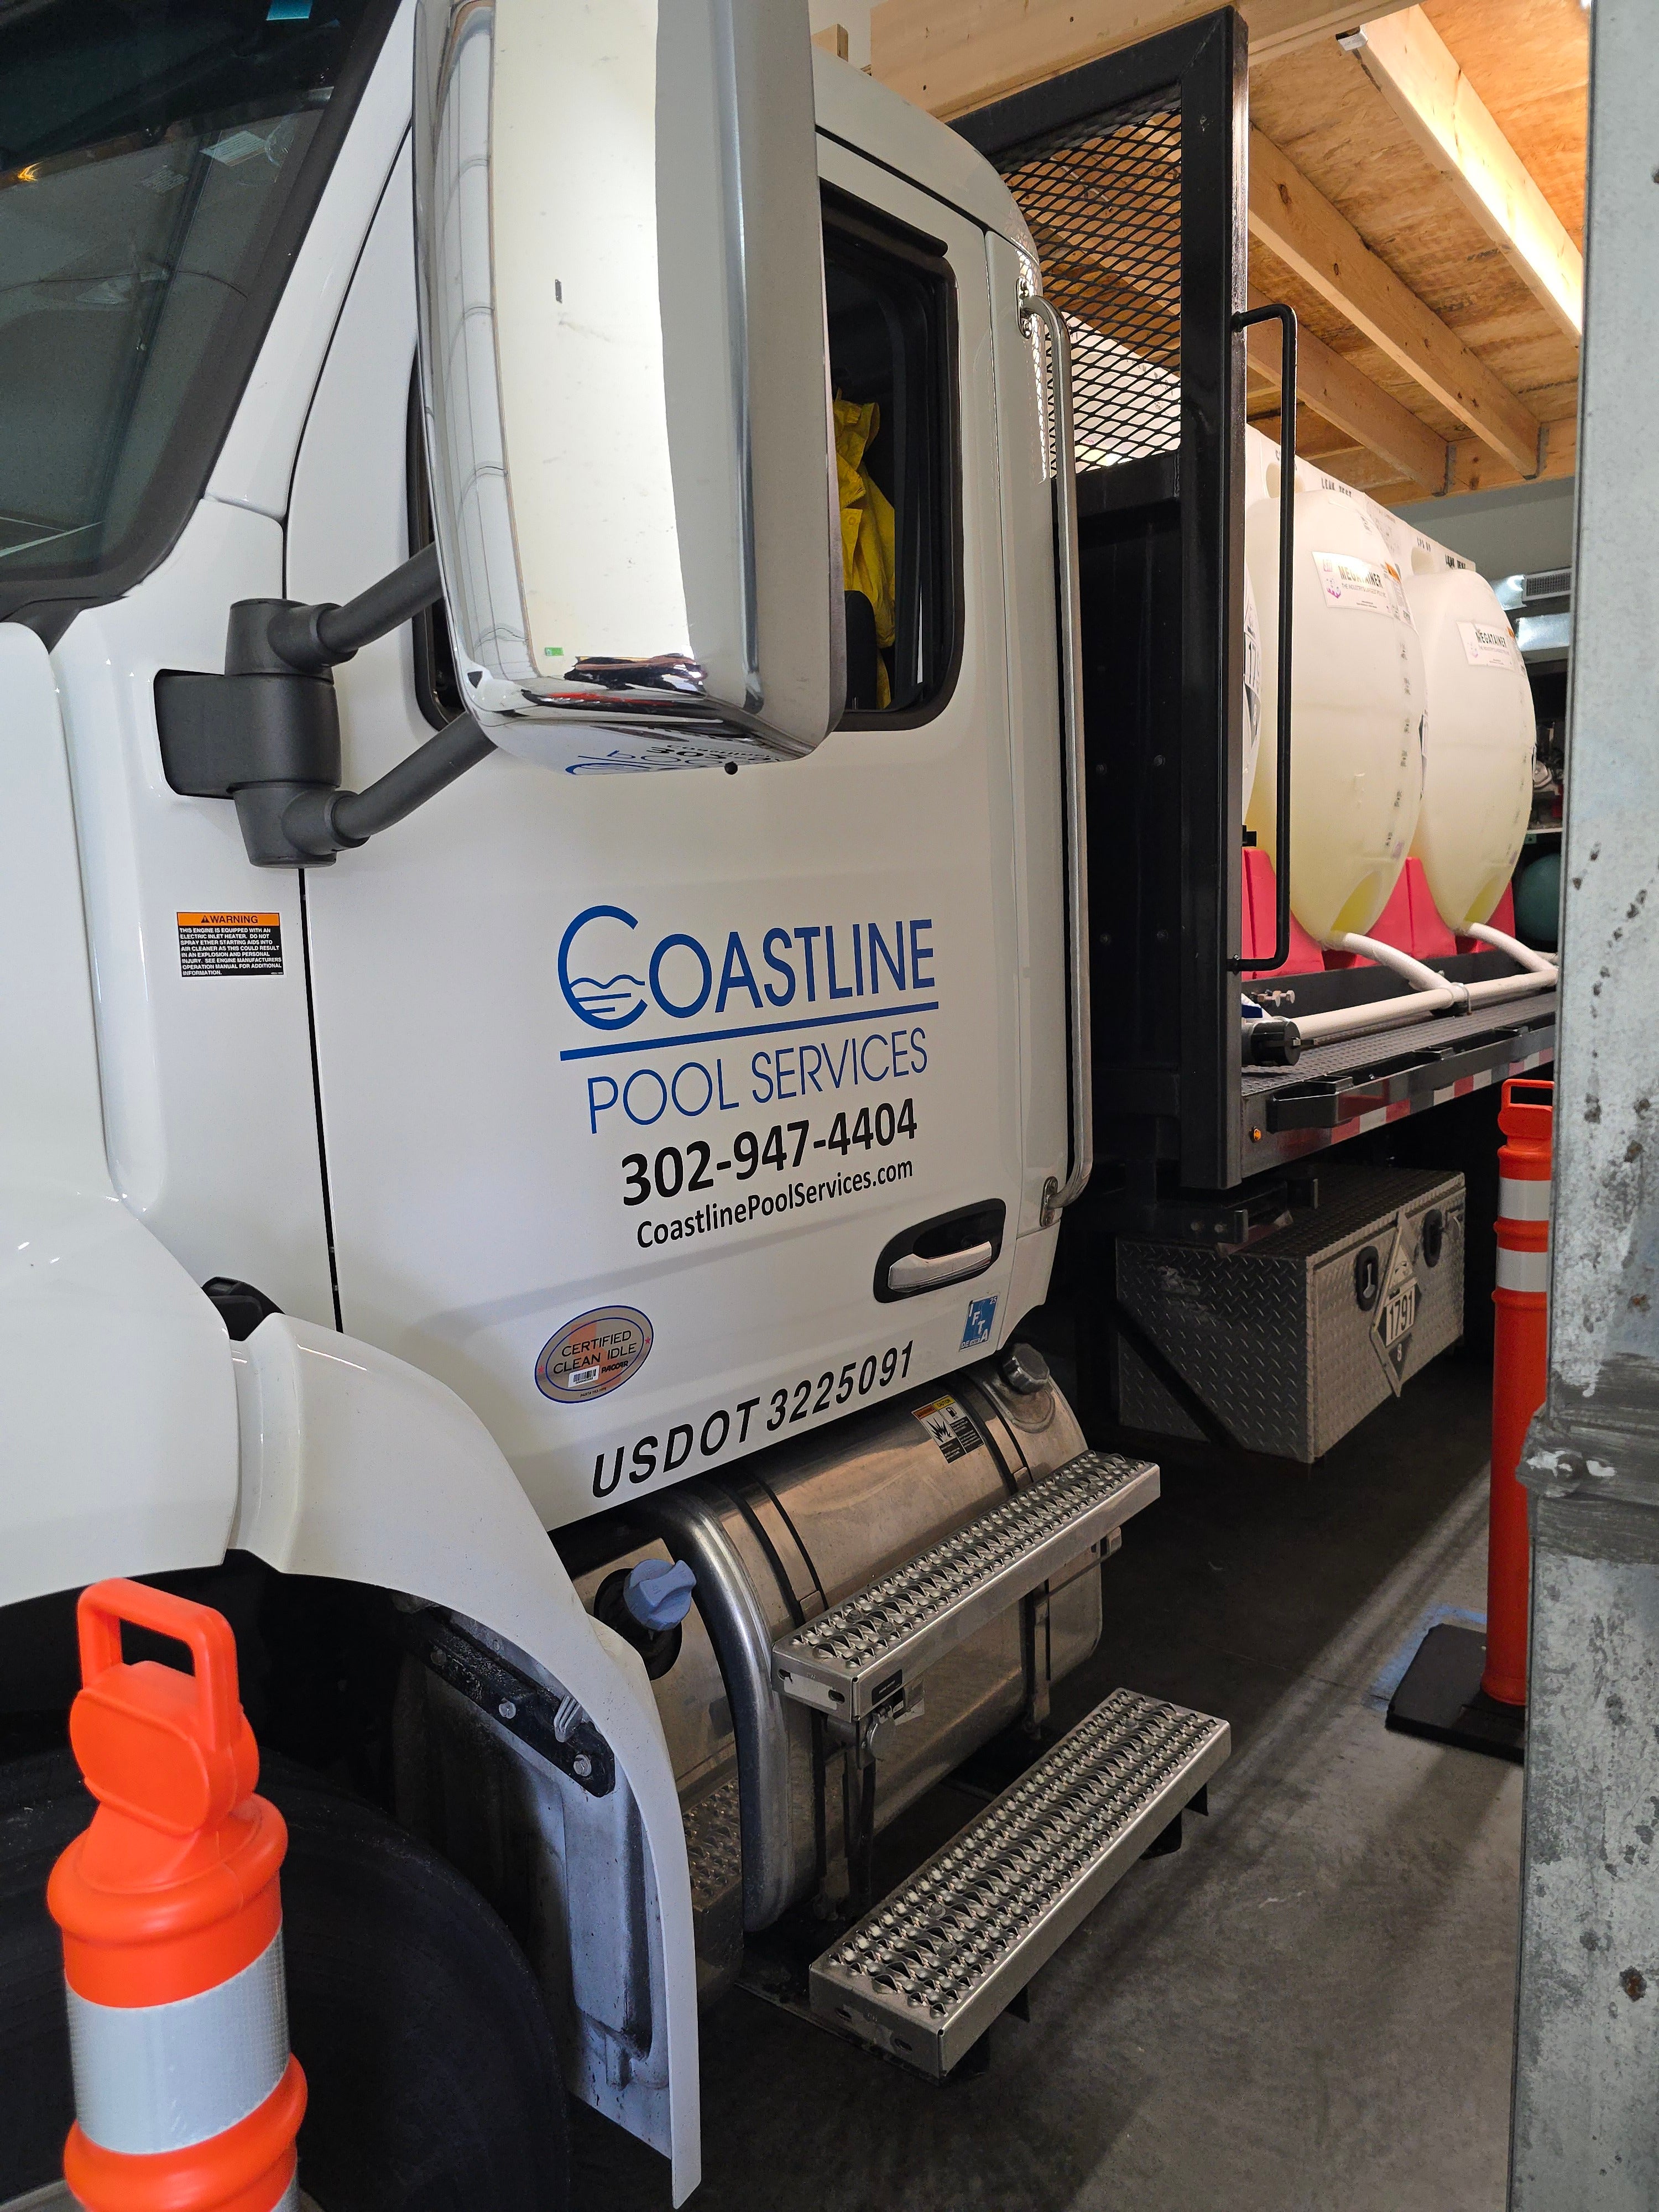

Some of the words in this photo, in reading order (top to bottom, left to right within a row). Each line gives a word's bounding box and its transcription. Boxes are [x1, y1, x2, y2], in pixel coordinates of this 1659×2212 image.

[1321, 477, 1335, 491] LEAK
[210, 915, 258, 924] WARNING
[557, 905, 936, 1030] COASTLINE
[587, 1058, 739, 1134] POOL
[752, 1027, 928, 1103] SERVICES
[621, 1098, 918, 1206] 302-947-4404
[637, 1160, 913, 1248] CoastlinePoolServices.com
[989, 1296, 997, 1305] 25
[1390, 1290, 1412, 1340] 1791
[553, 1353, 601, 1374] CLEAN
[607, 1343, 637, 1360] IDLE
[561, 1330, 632, 1357] CERTIFIED
[601, 1360, 629, 1374] PACCAR
[592, 1396, 760, 1498] USDOT
[766, 1340, 914, 1432] 3225091
